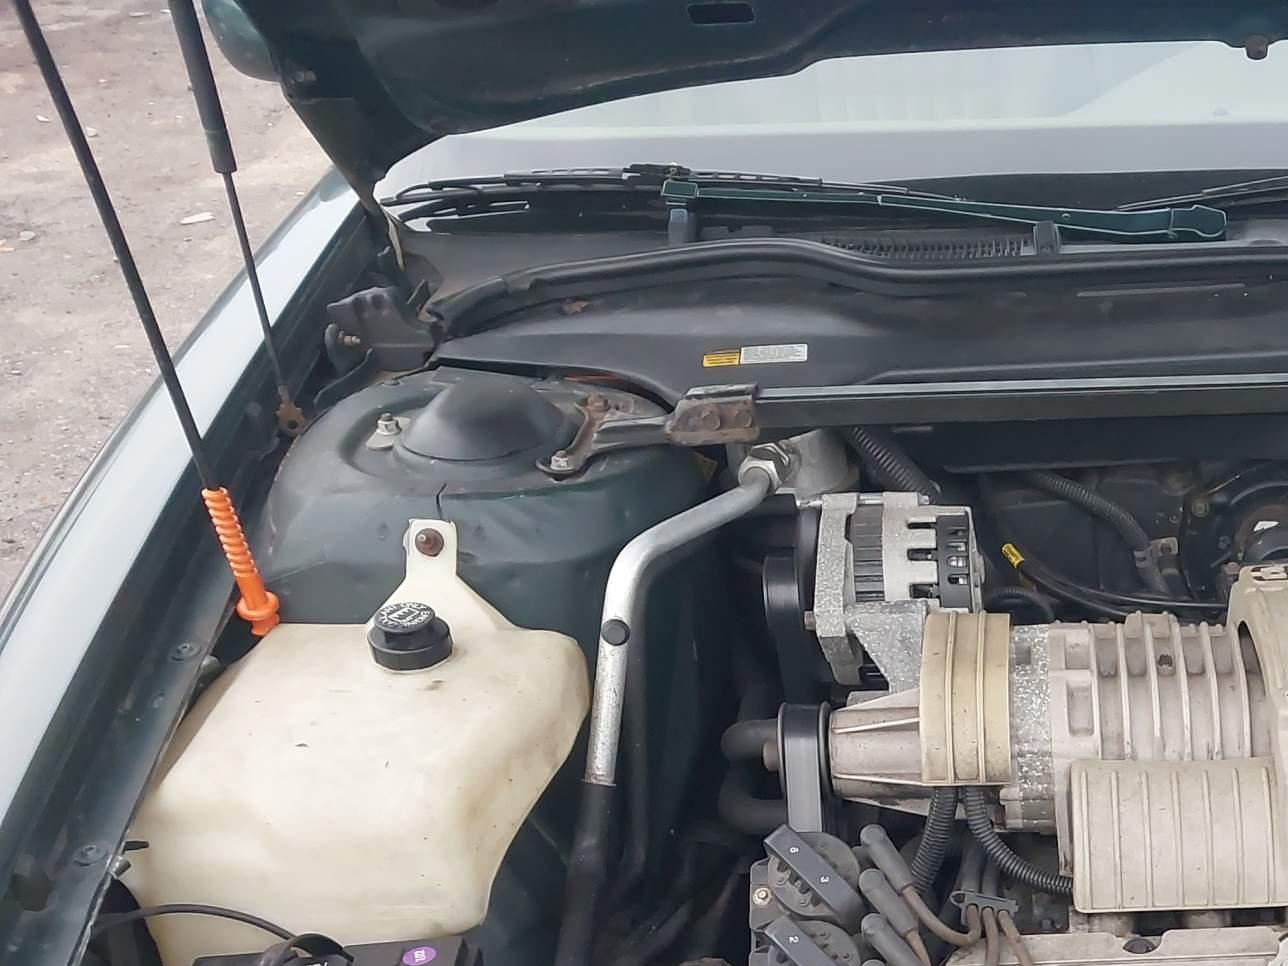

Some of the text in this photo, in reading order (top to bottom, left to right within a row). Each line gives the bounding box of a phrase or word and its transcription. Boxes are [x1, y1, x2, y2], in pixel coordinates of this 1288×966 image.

[789, 846, 800, 854] 6
[820, 875, 831, 883] 3
[788, 935, 800, 944] 2
